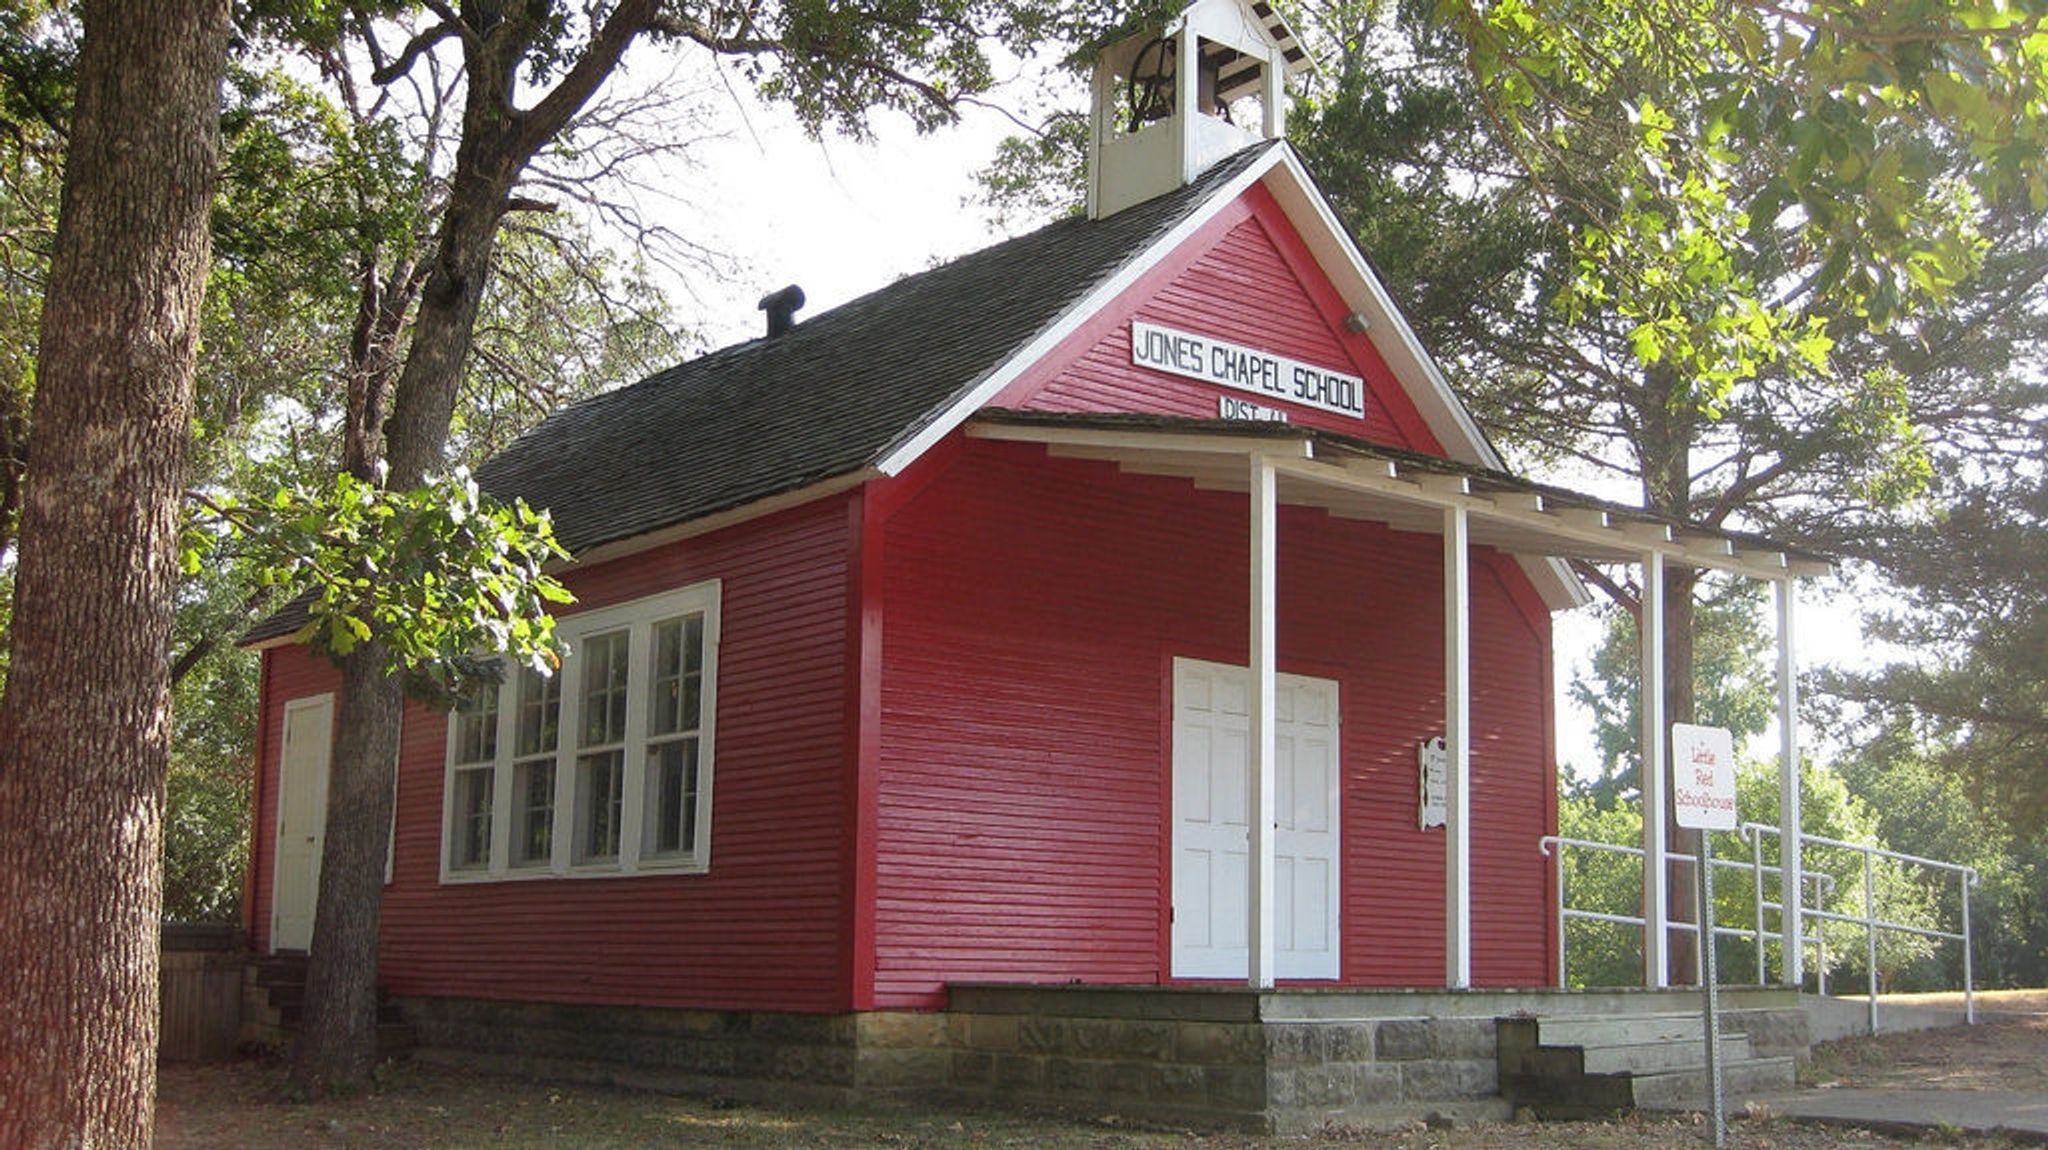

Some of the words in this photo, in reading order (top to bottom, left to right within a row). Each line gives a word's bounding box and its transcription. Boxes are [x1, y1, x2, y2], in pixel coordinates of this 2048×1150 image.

[1135, 330, 1203, 373] JONES
[1212, 346, 1285, 393] CHAPEL
[1293, 367, 1362, 413] SCHOOL
[1691, 746, 1716, 766] Little
[1695, 768, 1713, 787] Red
[1676, 788, 1734, 811] Schoolhouse
